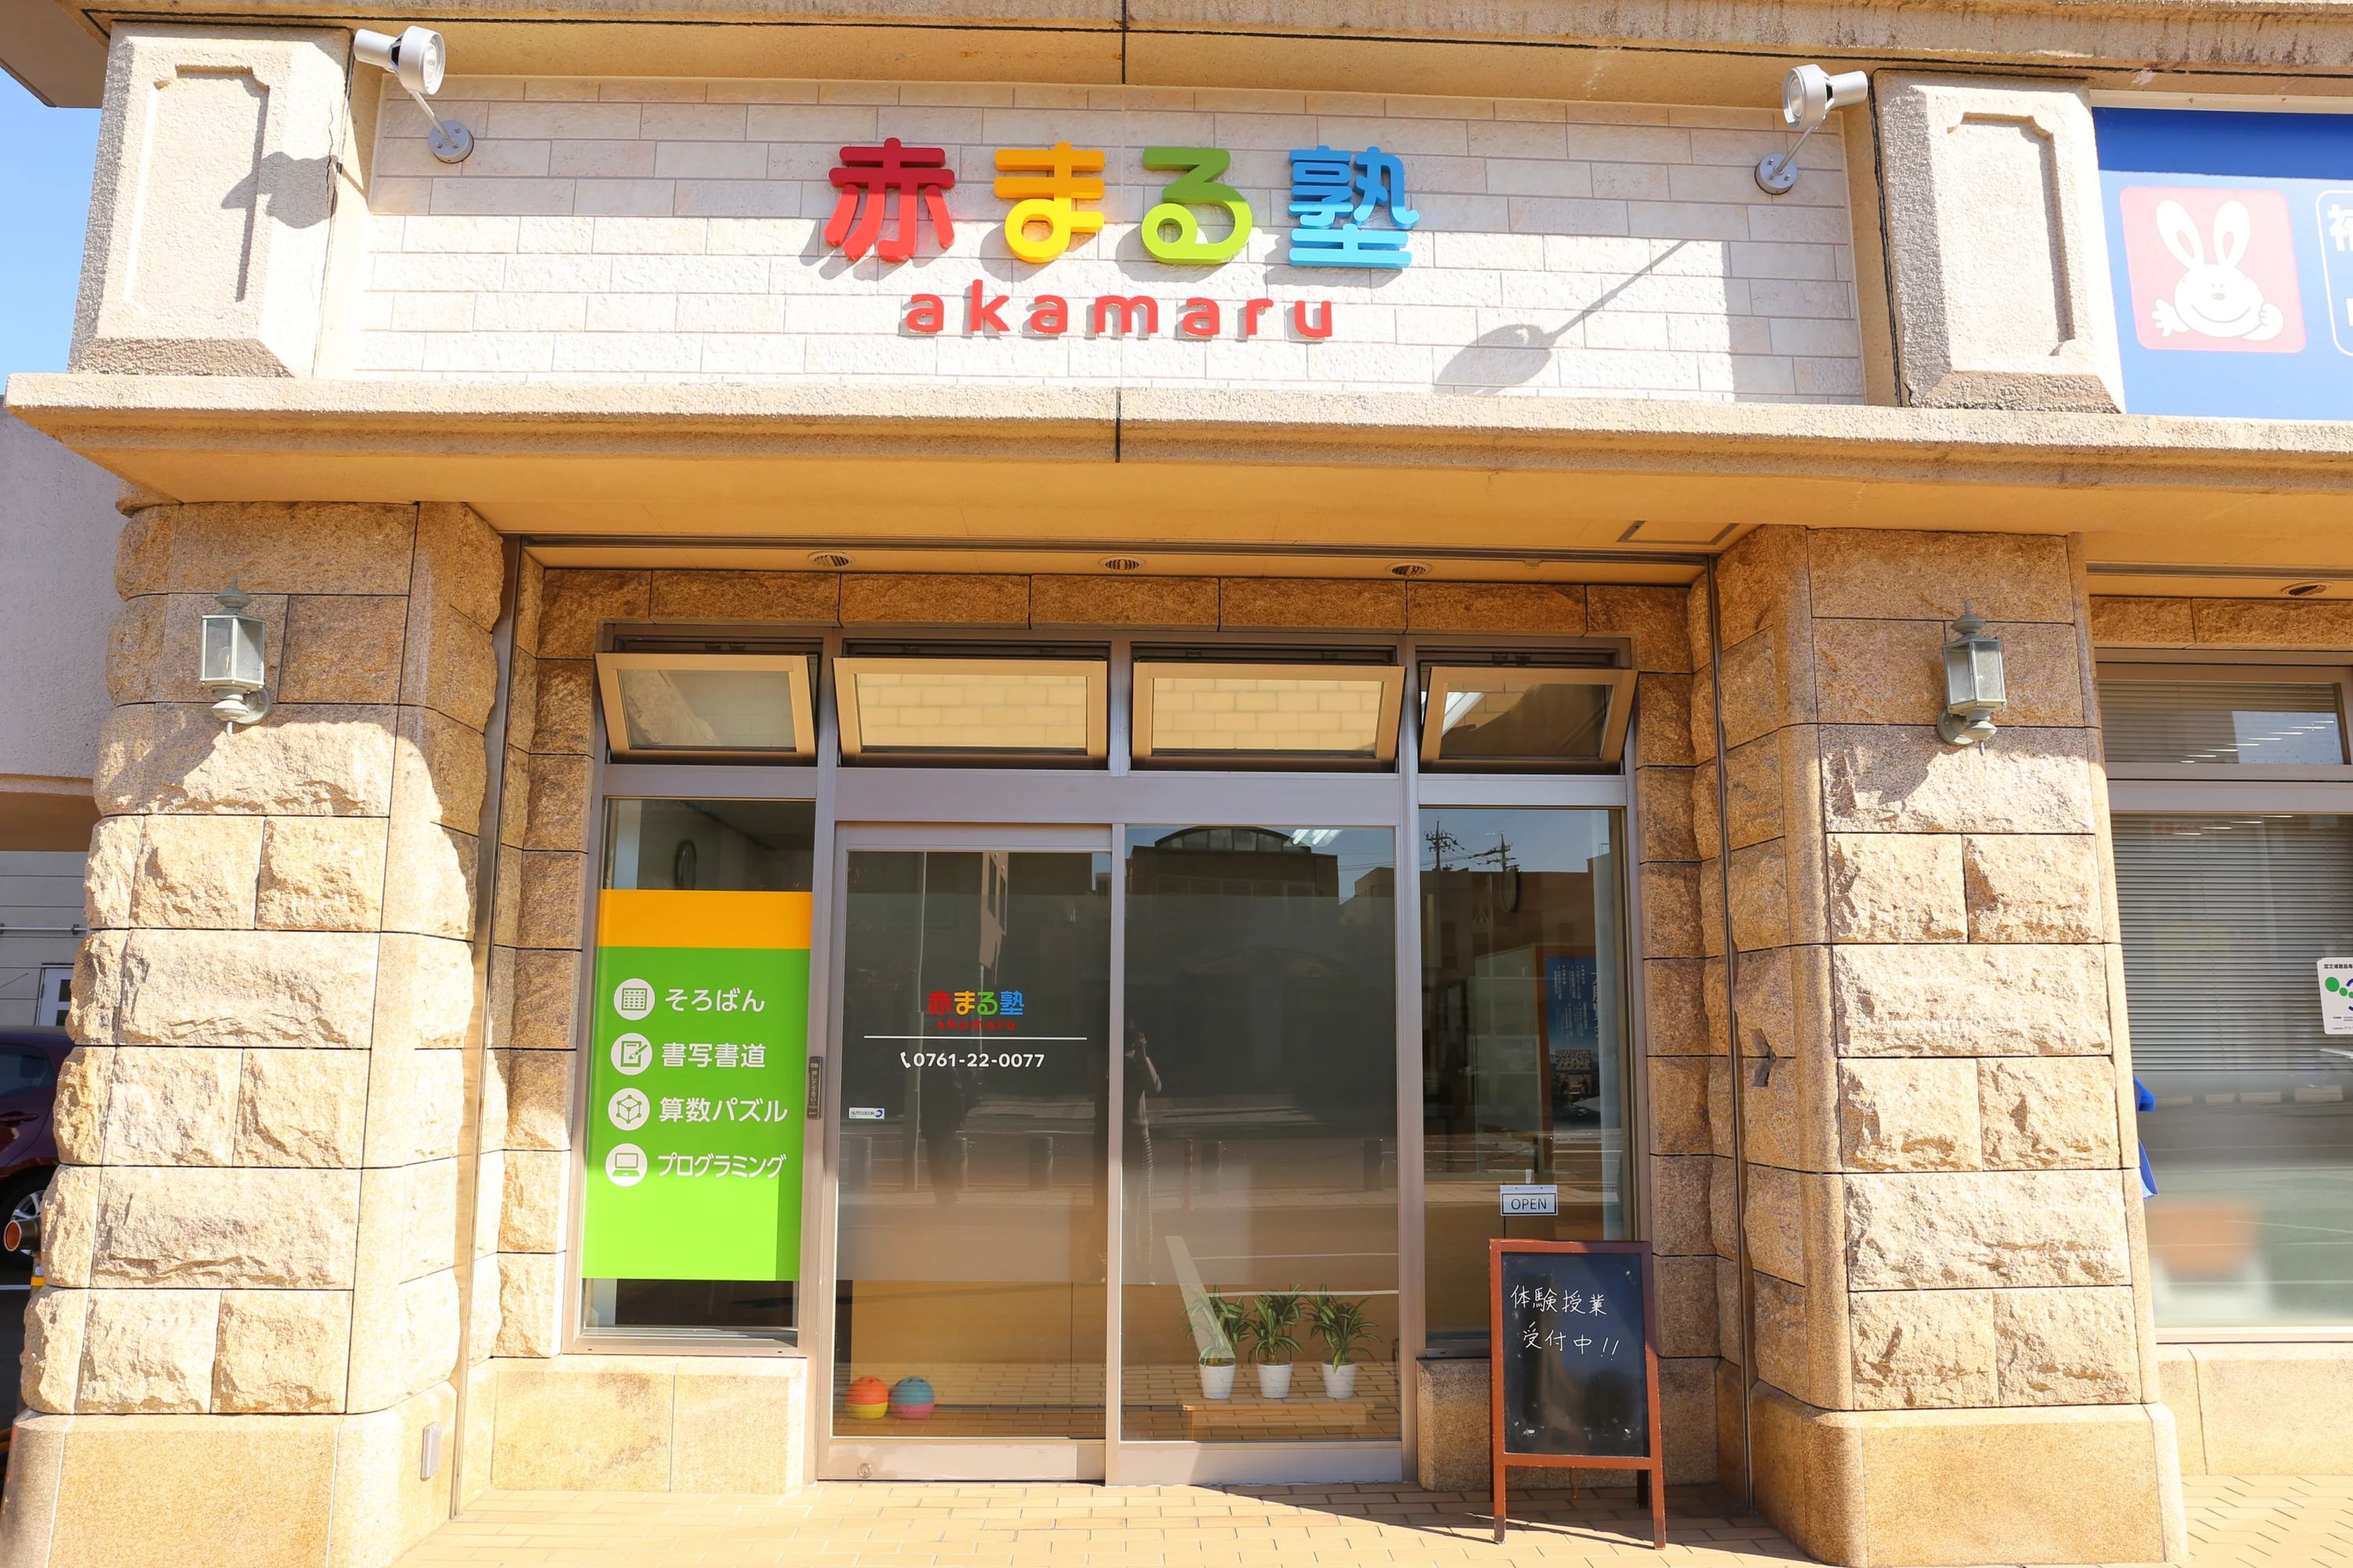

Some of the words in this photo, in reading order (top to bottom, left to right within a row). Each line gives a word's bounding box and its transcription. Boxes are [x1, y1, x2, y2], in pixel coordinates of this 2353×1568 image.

[824, 137, 1420, 269] 赤まる塾
[904, 278, 1333, 339] akamaru
[665, 988, 766, 1013] そろばん
[927, 988, 1025, 1016] 赤まる塾
[936, 1018, 1017, 1031] akamaru
[661, 1042, 766, 1069] 書写書道
[913, 1053, 1046, 1068] 0761-22-0077
[659, 1097, 788, 1123] 算数パズル
[657, 1151, 787, 1178] プログラミング
[1511, 1198, 1547, 1211] OPEN
[1510, 1284, 1607, 1316] 体験授業
